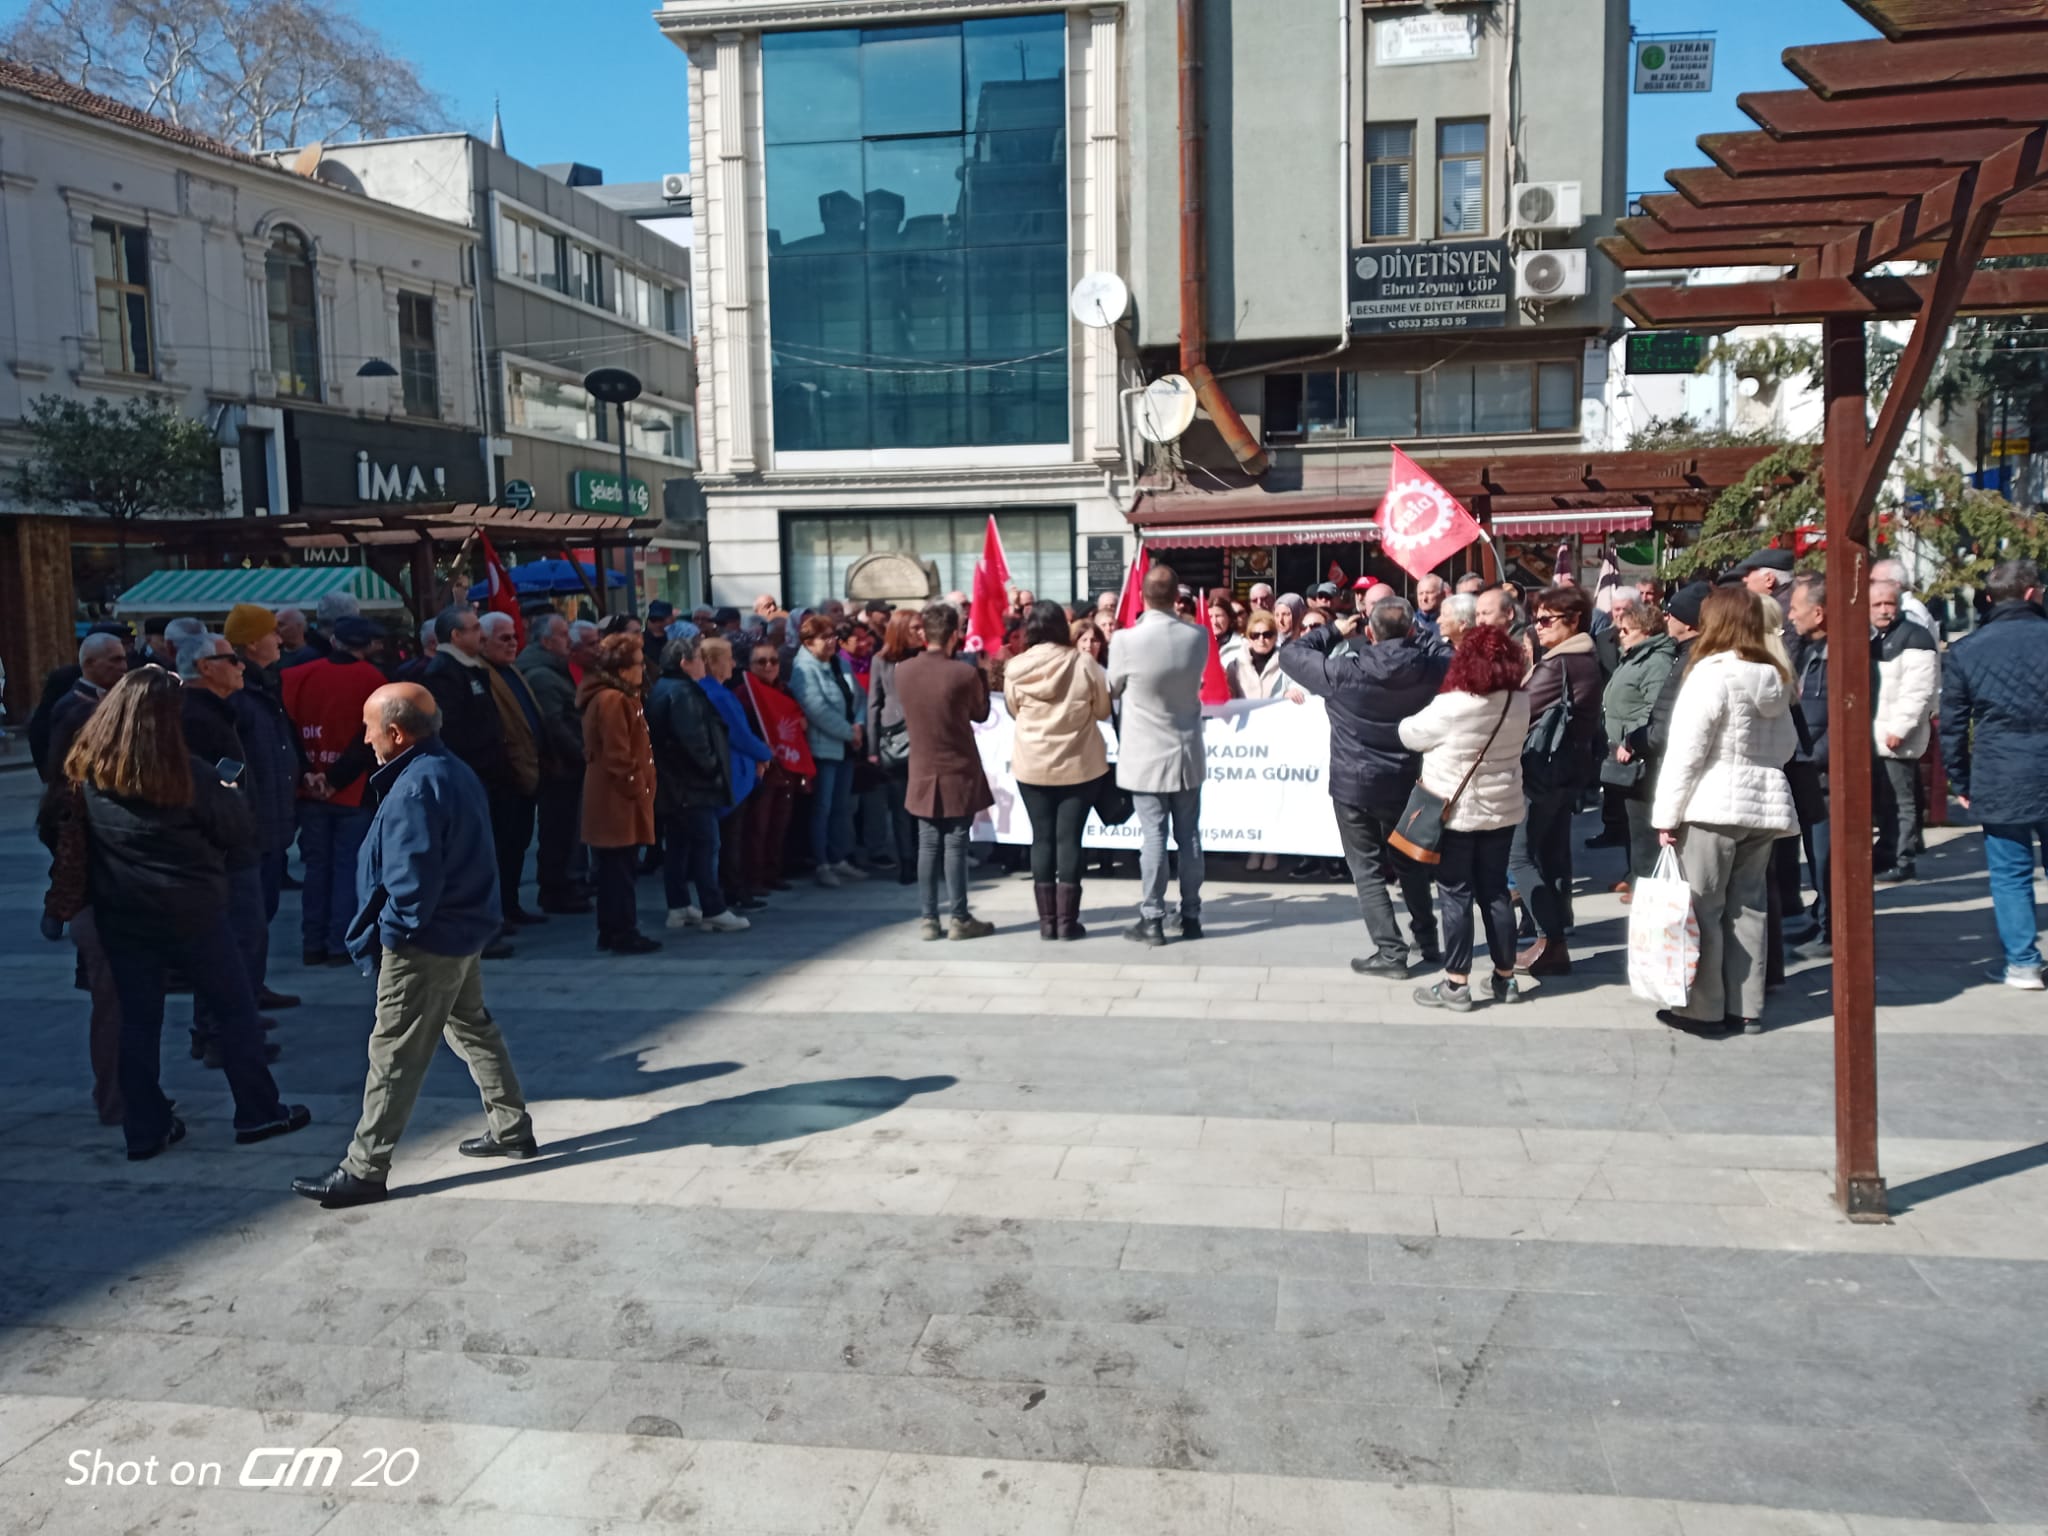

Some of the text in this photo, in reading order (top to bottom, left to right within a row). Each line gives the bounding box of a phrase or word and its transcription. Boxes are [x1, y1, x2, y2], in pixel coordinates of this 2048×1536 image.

[1669, 43, 1710, 53] UZMAN
[1381, 245, 1501, 279] DİYETİSYEN
[1382, 276, 1497, 297] Ebru Zeynep ÇÖP
[1356, 298, 1501, 316] BESLENME VE DİYET MERKEZİ
[1397, 316, 1467, 329] 0533 255 83 95
[589, 479, 637, 505] Şekerbk
[1206, 744, 1269, 758] KADIN
[1206, 764, 1320, 783] IŞMA GÜNÜ
[1201, 828, 1263, 841] IŞMASI
